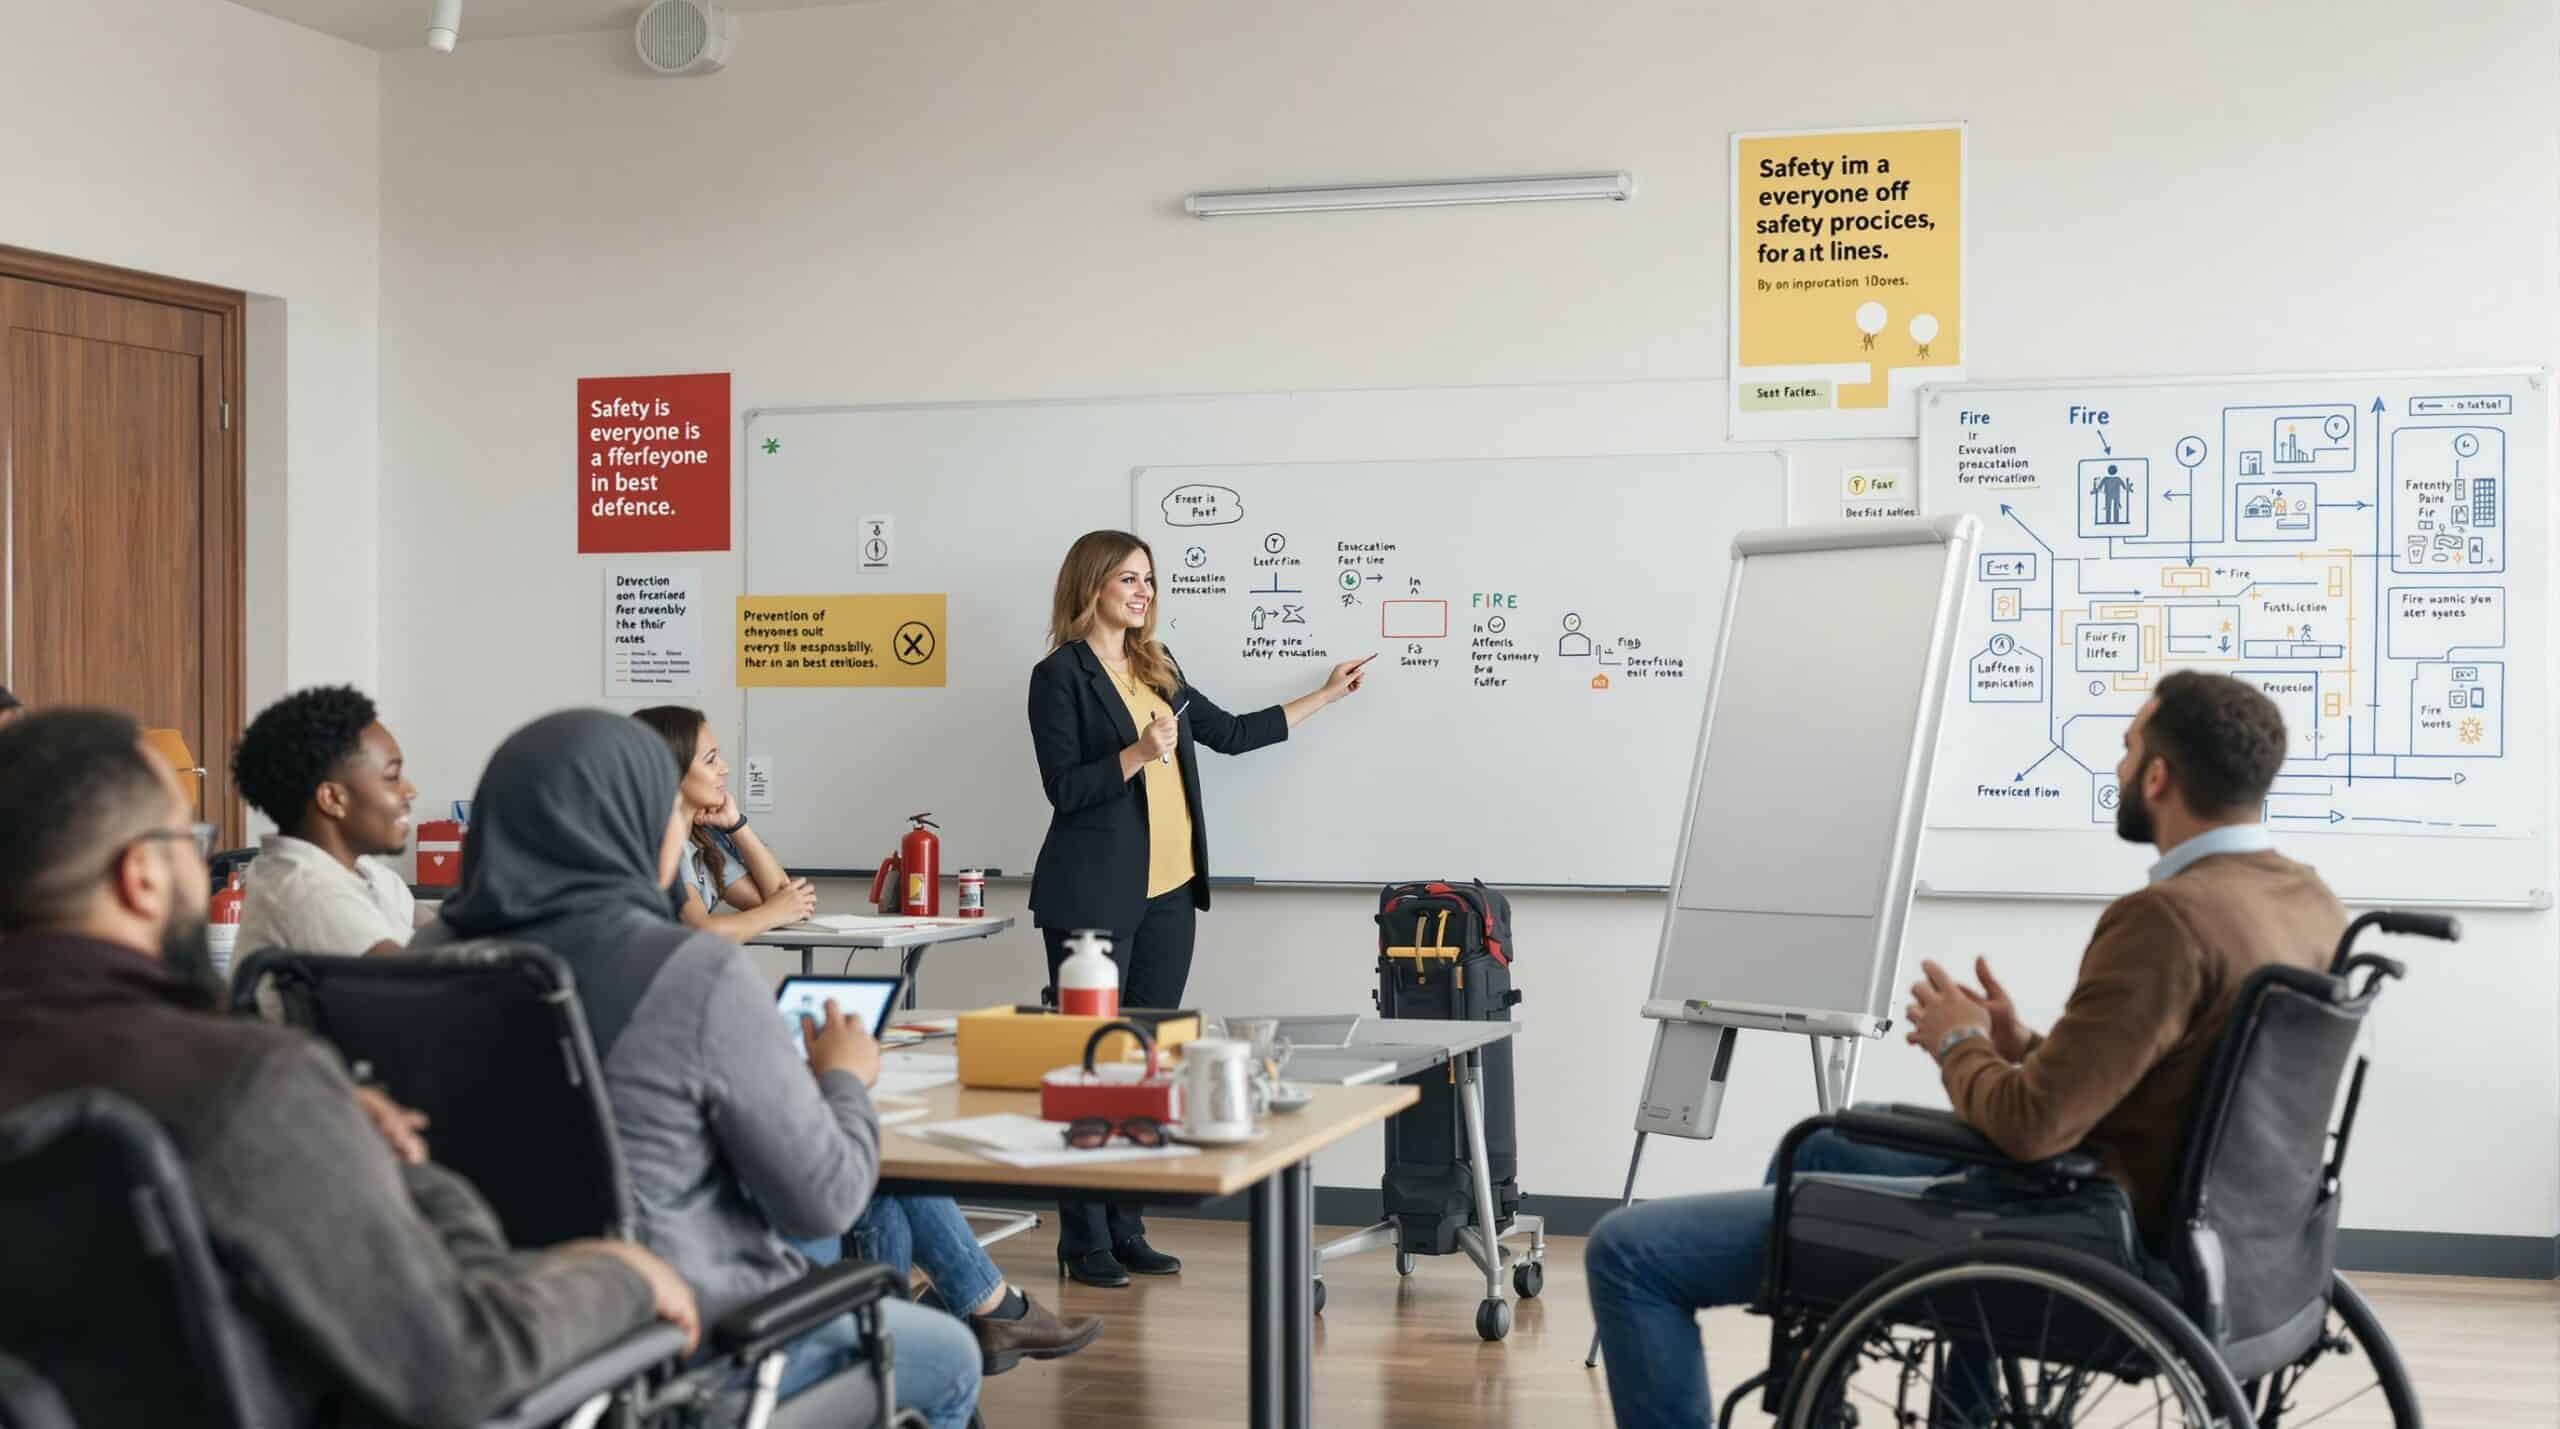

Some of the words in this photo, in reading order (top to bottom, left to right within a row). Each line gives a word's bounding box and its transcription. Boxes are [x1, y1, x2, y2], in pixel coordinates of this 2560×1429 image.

[1759, 156, 1834, 180] Safety
[1841, 155, 1869, 175] im
[1877, 158, 1890, 173] a
[1759, 187, 1869, 209] everyone
[1876, 181, 1910, 202] off
[1756, 214, 1823, 236] safety
[1830, 210, 1936, 235] procices,
[1758, 244, 1789, 263] for
[1831, 241, 1888, 261] lines.
[1758, 280, 1772, 292] By
[1776, 282, 1789, 290] on
[591, 398, 649, 421] Safety
[655, 398, 670, 416] is
[1960, 411, 1990, 424] Fire
[2069, 406, 2109, 424] Fire
[591, 426, 679, 445] everyone
[685, 422, 701, 439] is
[591, 452, 601, 466] a
[592, 474, 608, 491] in
[616, 472, 658, 491] best
[592, 498, 676, 516] defence.
[1472, 593, 1517, 608] FIRE
[744, 610, 809, 621] Prevention
[813, 610, 826, 621] of
[803, 657, 826, 668] best
